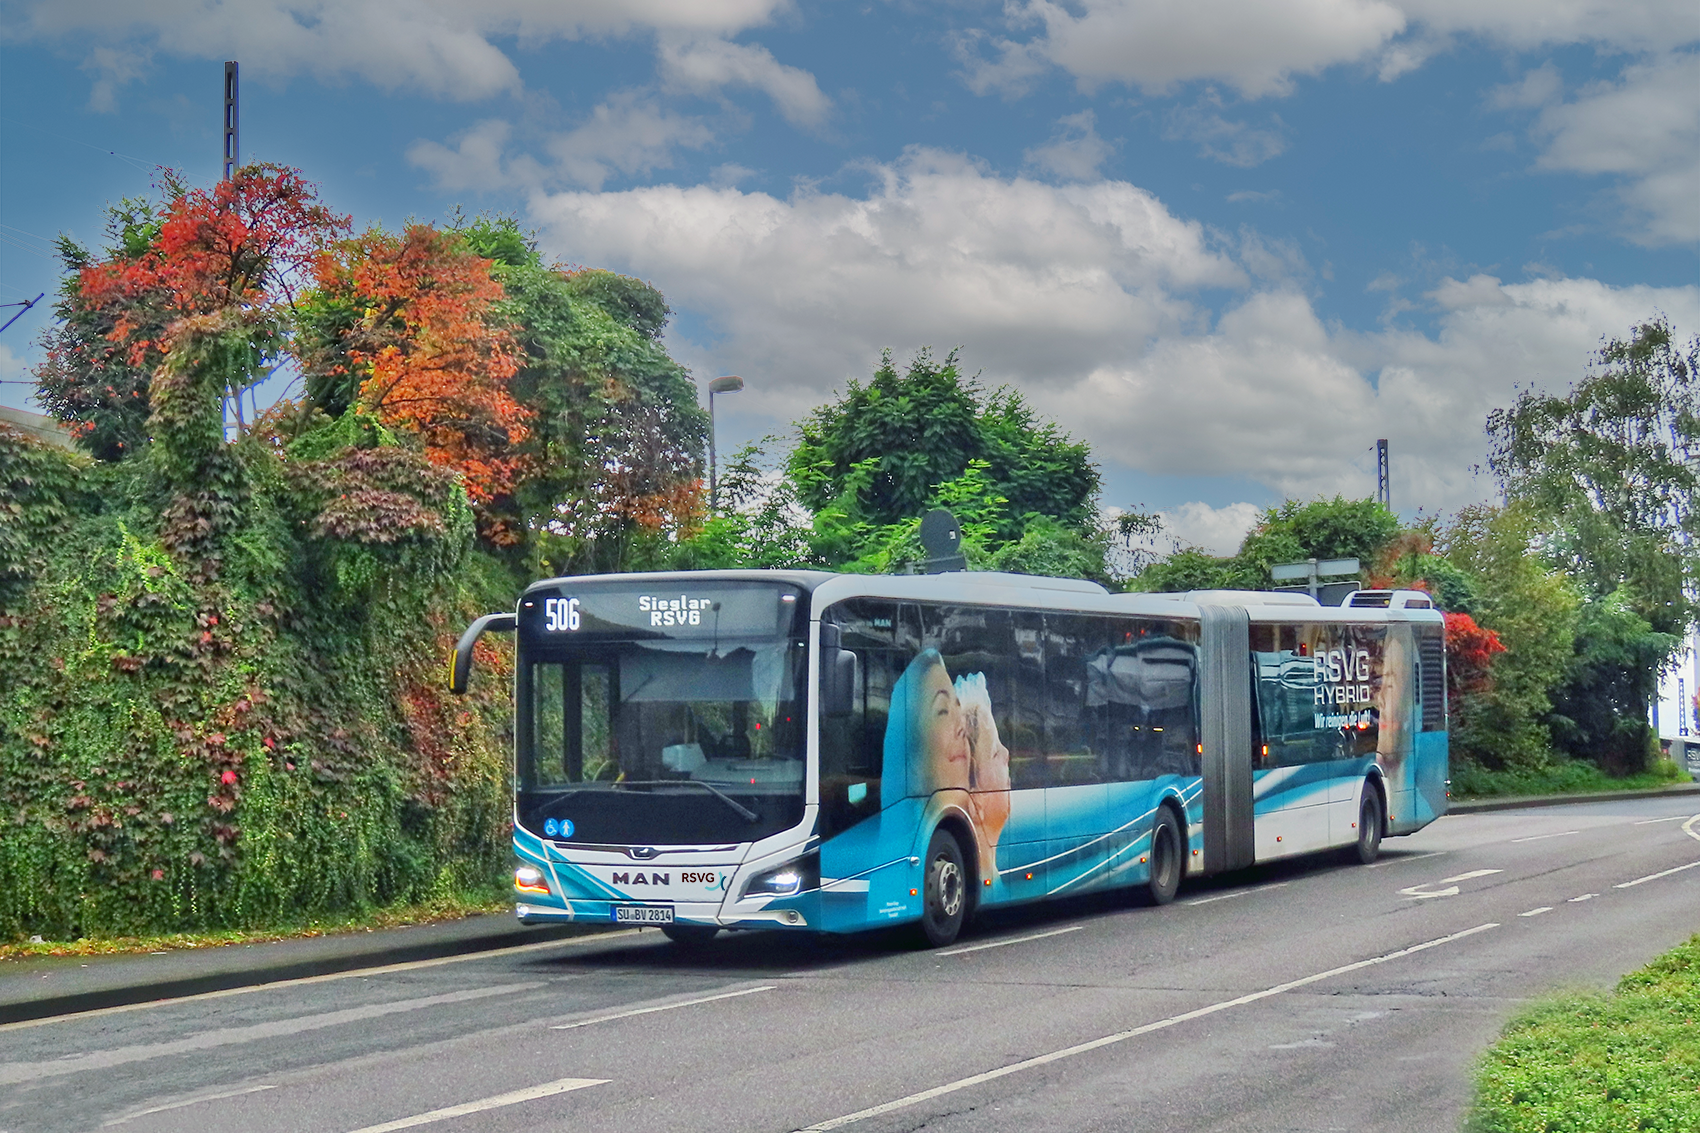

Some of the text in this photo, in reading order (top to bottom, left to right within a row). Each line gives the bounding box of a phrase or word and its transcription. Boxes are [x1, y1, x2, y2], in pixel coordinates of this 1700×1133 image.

[639, 595, 711, 611] Sieglar
[545, 598, 580, 631] 506
[651, 610, 700, 626] RSVG
[874, 618, 892, 627] MAN
[1313, 649, 1370, 682] RSVG
[1313, 685, 1370, 705] HYBRID
[1314, 713, 1325, 729] Wir
[612, 872, 670, 885] MAN
[681, 872, 715, 883] RSVG
[617, 909, 672, 921] SU BV 2814
